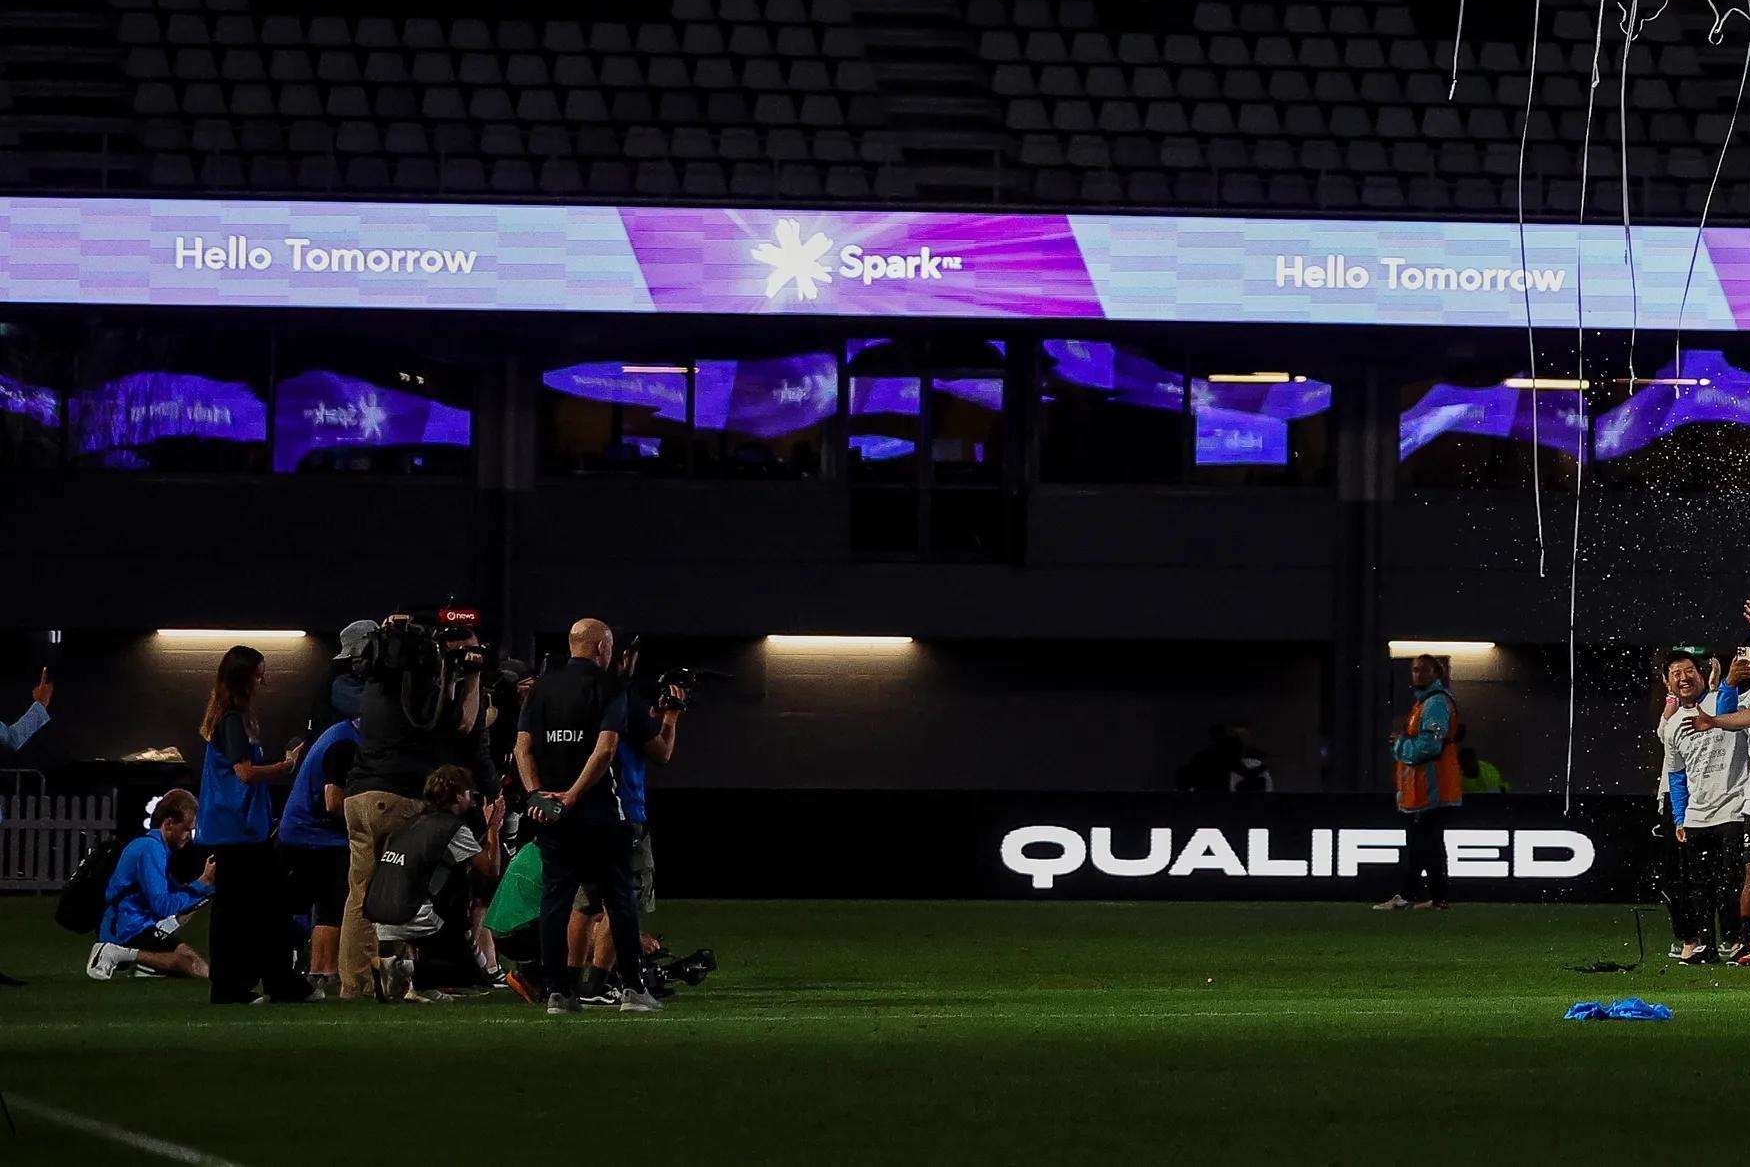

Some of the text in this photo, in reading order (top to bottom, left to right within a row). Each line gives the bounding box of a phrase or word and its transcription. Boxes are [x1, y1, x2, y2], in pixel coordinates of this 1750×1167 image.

[175, 235, 477, 274] Hello Tomorrow
[1275, 254, 1566, 292] Hello Tomorrow
[546, 729, 584, 743] MEDIA
[380, 850, 406, 866] EDIA
[1000, 825, 1596, 888] QUALIFED
